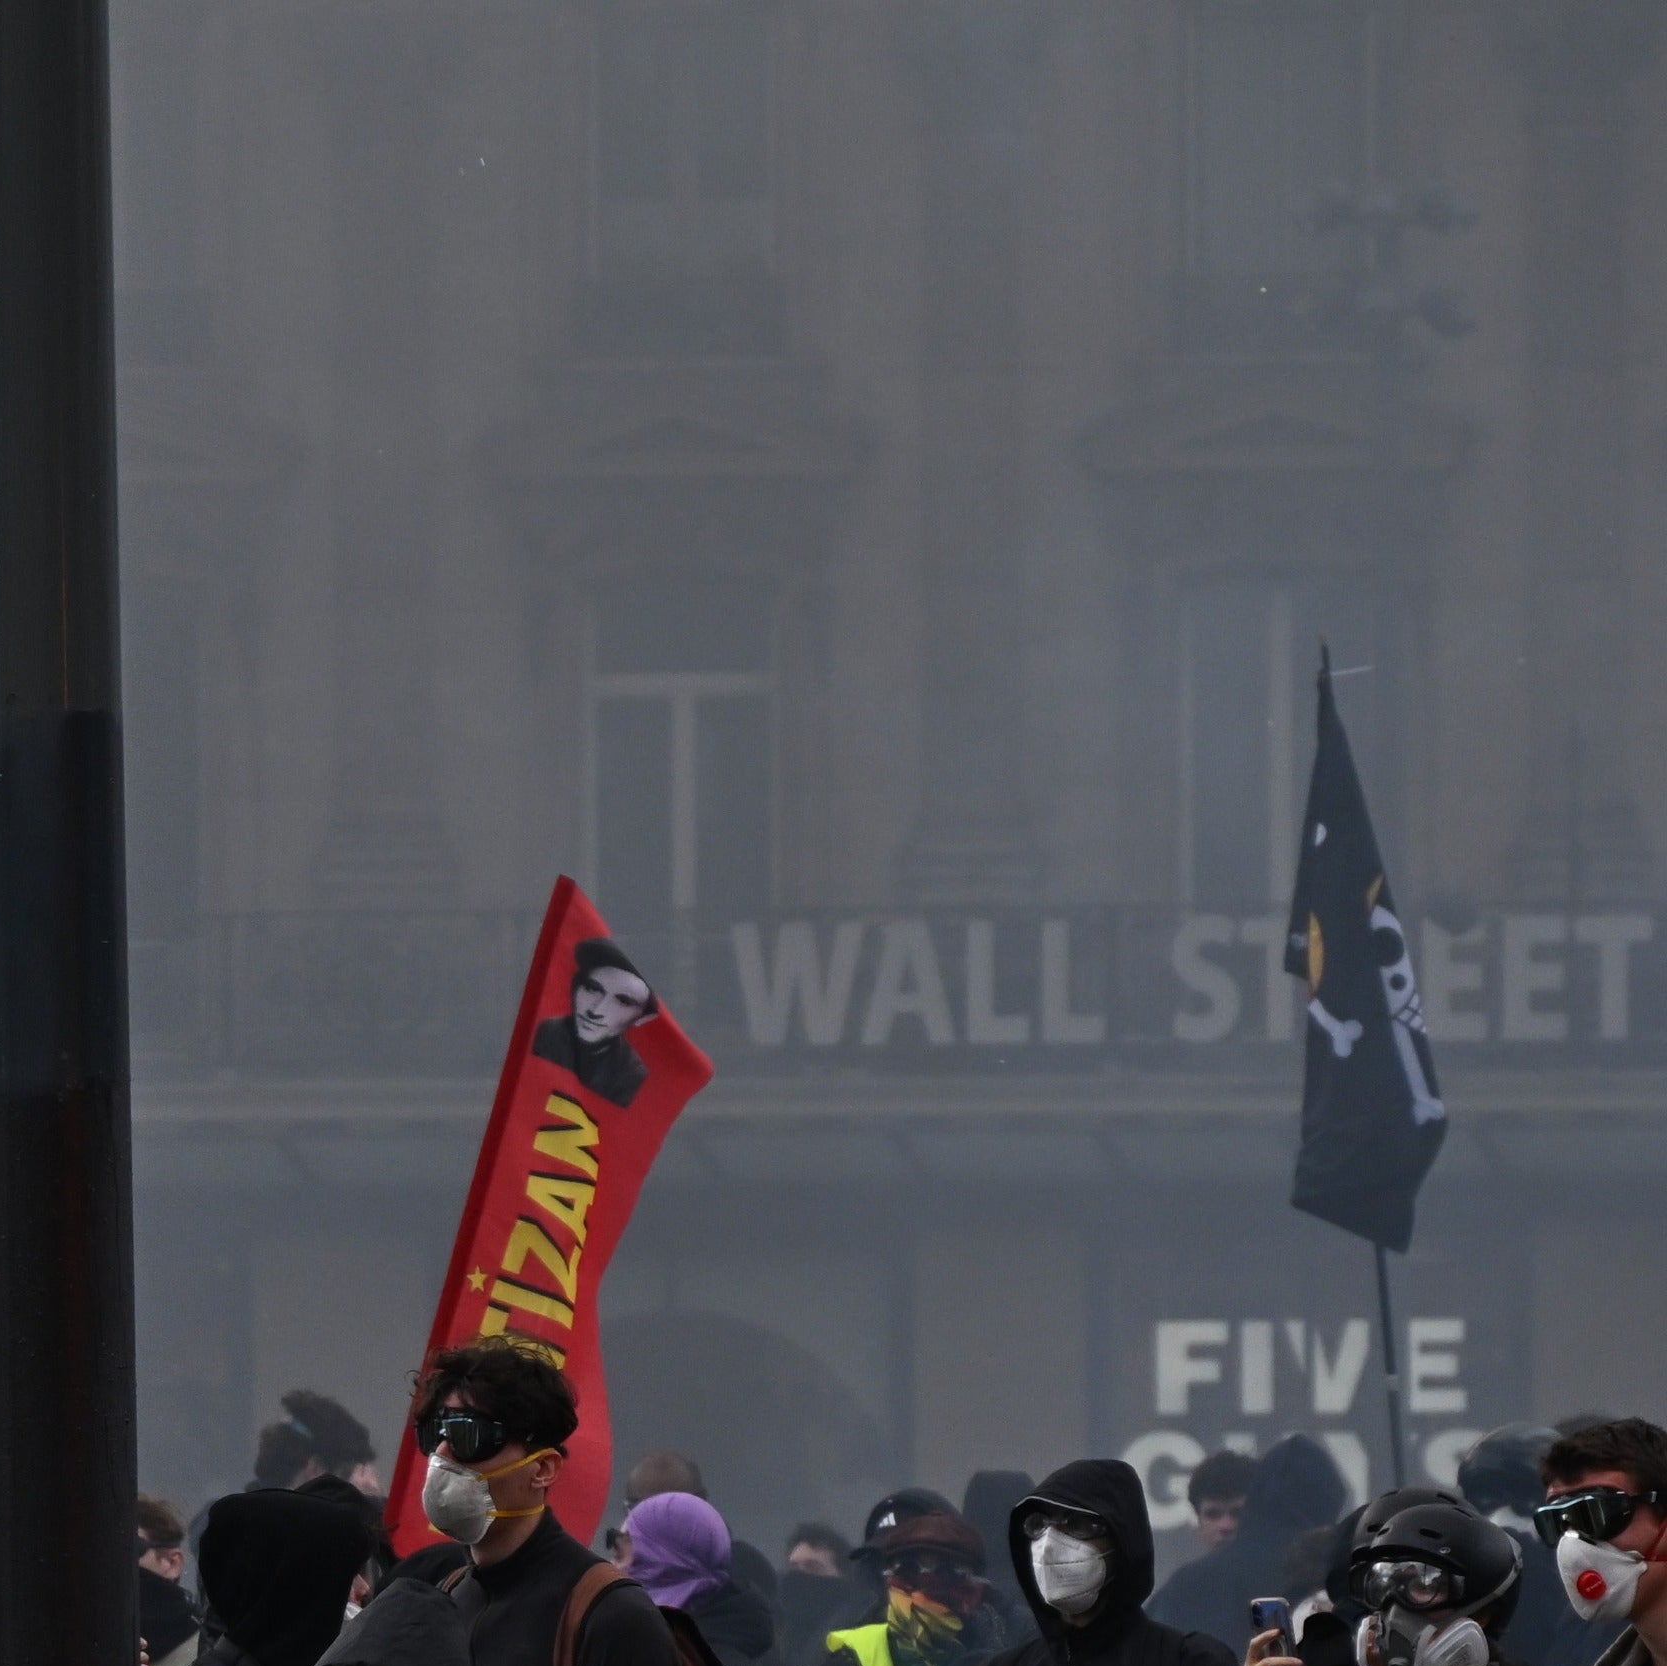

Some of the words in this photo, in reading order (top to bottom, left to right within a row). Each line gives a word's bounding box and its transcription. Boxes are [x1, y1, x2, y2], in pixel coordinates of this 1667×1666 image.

[730, 915, 1104, 1046] WALL
[1171, 913, 1654, 1044] STEET
[479, 1089, 600, 1371] TIZAN
[1154, 1317, 1468, 1417] FIVE
